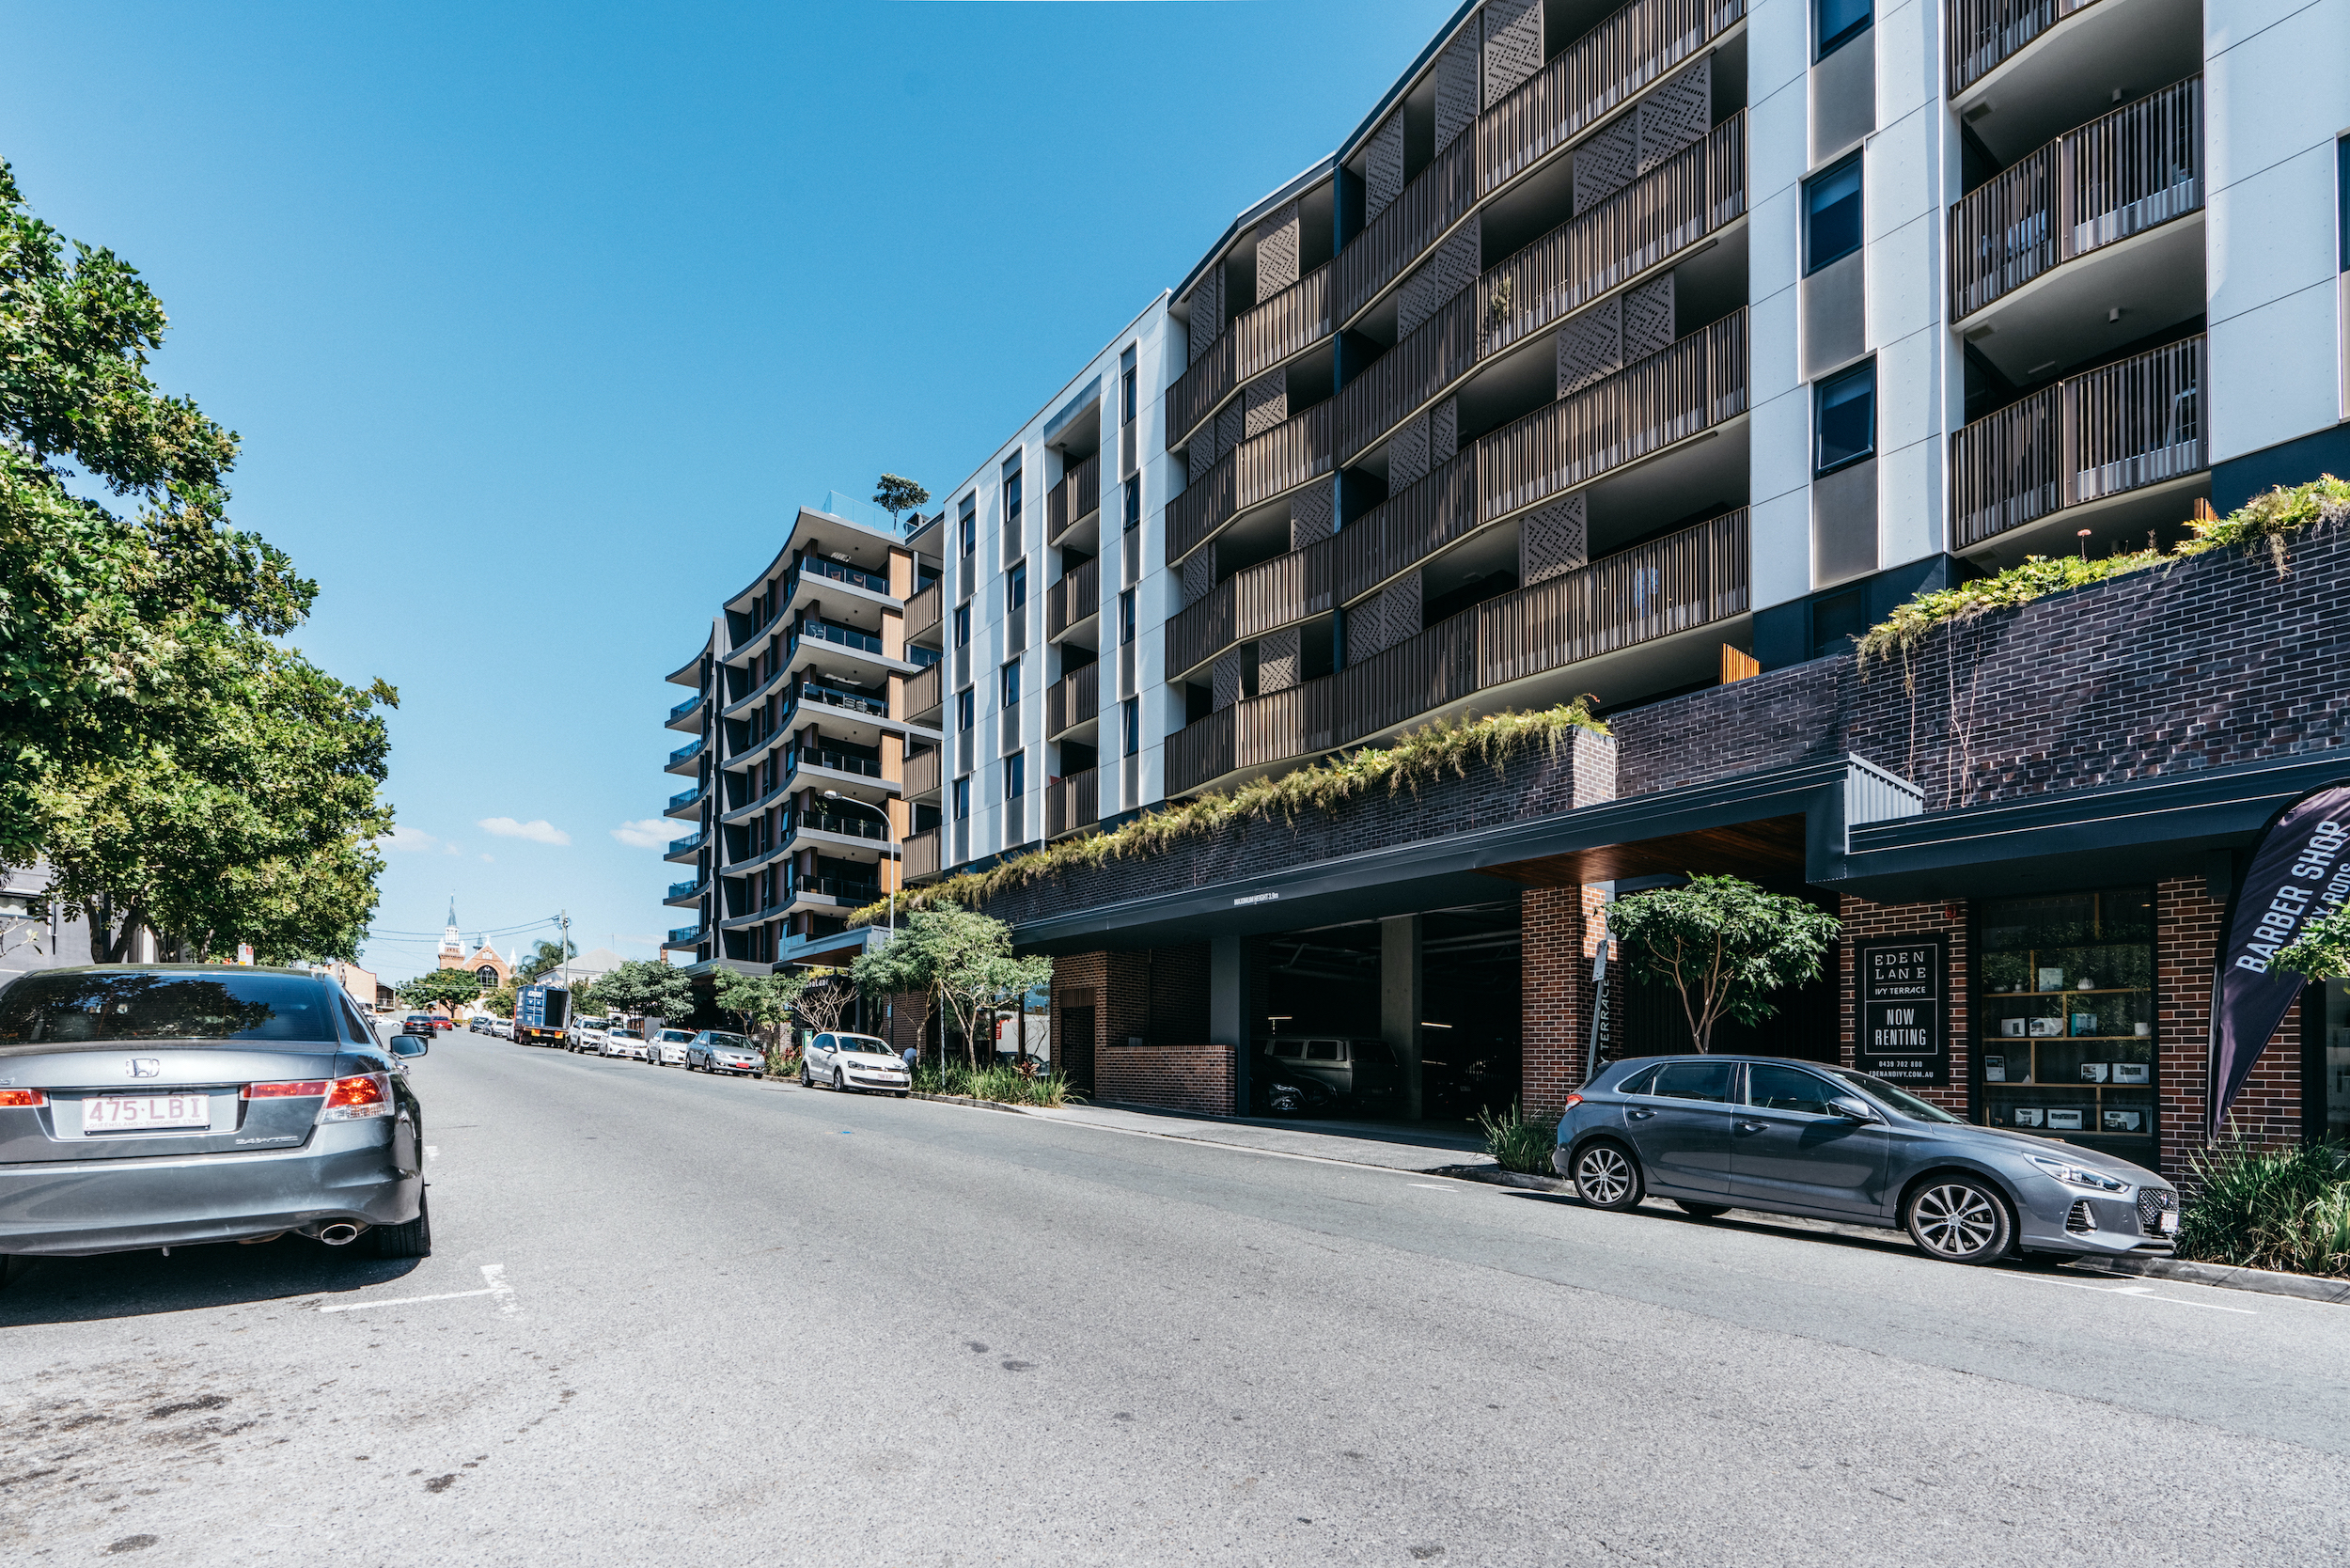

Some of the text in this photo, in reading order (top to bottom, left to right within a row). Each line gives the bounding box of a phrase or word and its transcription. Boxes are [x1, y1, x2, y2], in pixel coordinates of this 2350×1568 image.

[2234, 885, 2313, 974] BARBER
[2291, 820, 2349, 880] SHOP
[1874, 950, 1925, 965] EDEN
[1874, 967, 1926, 980] LANE
[1874, 986, 1926, 996] IVY TERRACE
[1600, 979, 1610, 1051] TERRACE
[1887, 1008, 1915, 1026] NOW
[1874, 1028, 1927, 1045] RENTING
[88, 1121, 139, 1129] QUEENSLAND
[145, 1119, 180, 1127] SUNSHINE
